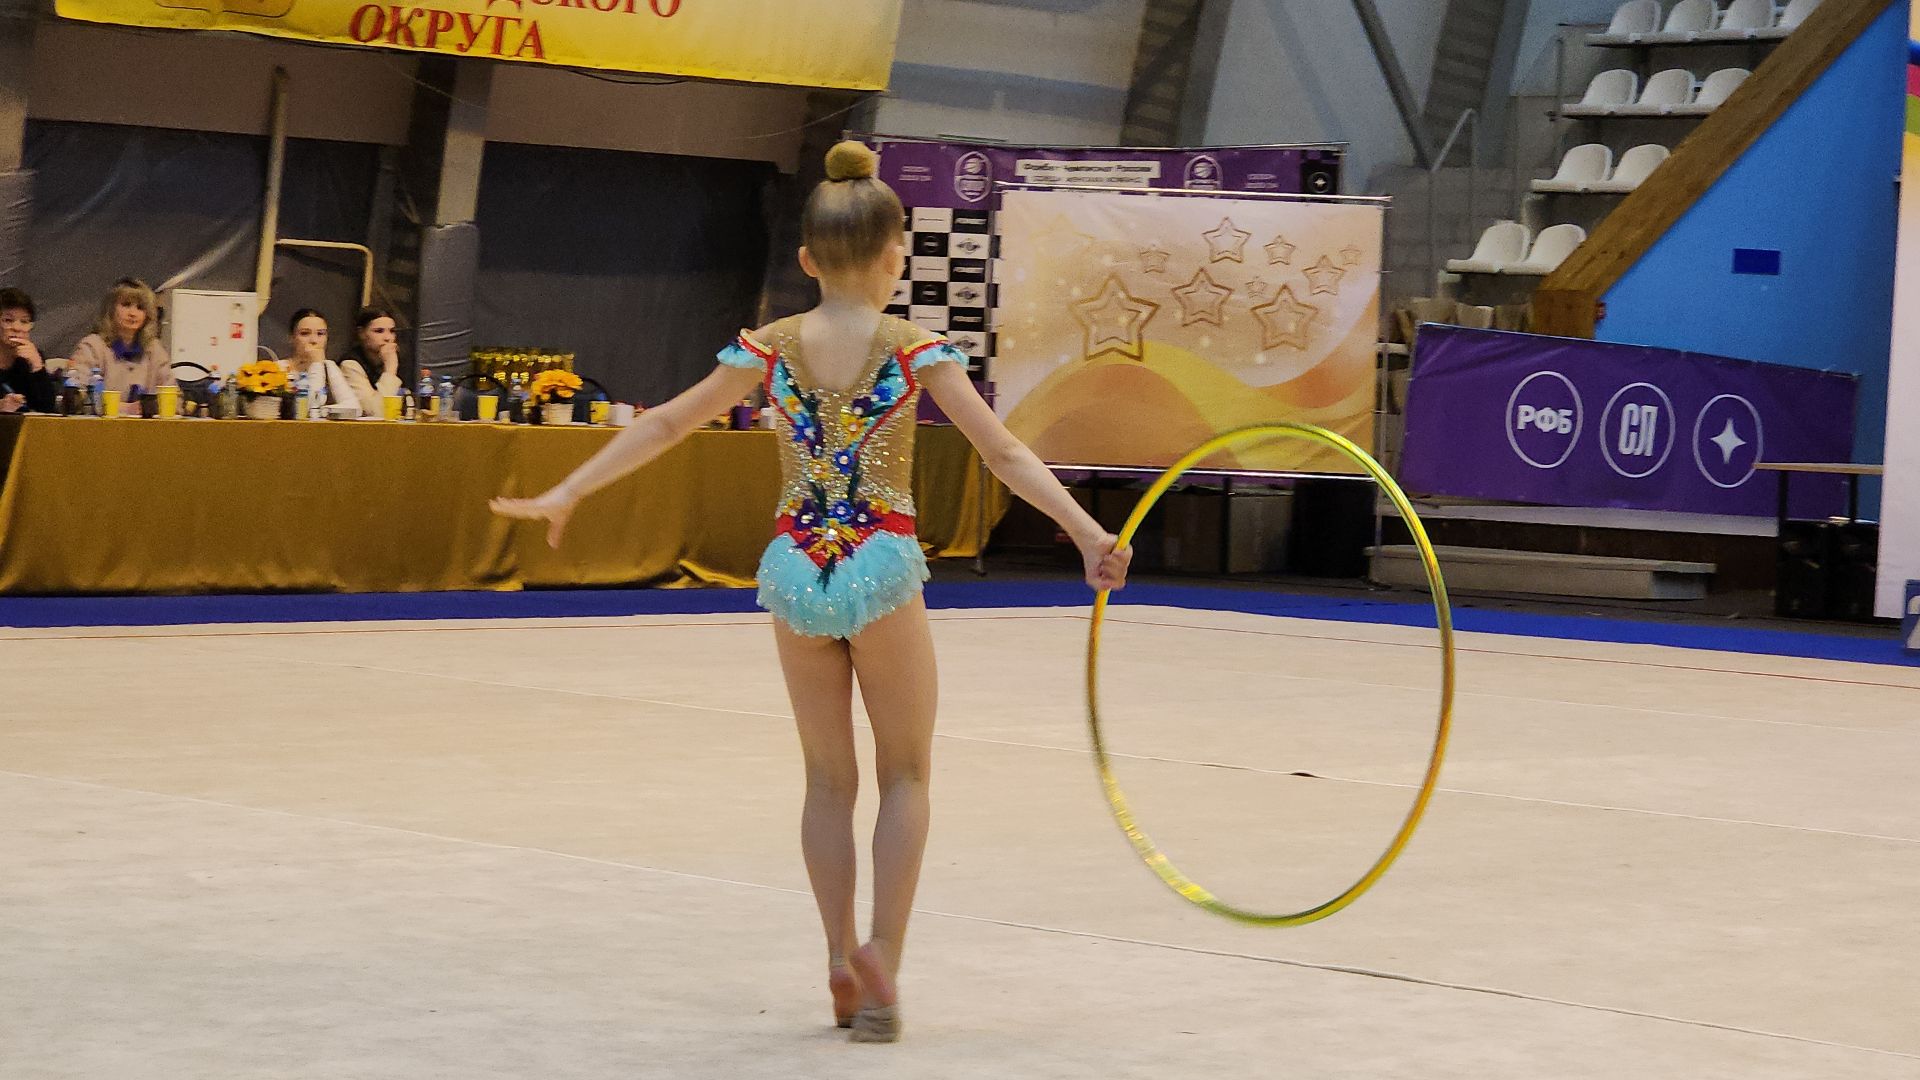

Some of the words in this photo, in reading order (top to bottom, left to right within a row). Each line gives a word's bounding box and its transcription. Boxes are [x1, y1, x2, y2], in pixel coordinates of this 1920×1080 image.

[350, 4, 546, 59] ОКРУГА
[1517, 404, 1573, 434] РФБ
[1618, 402, 1658, 456] СЛ
